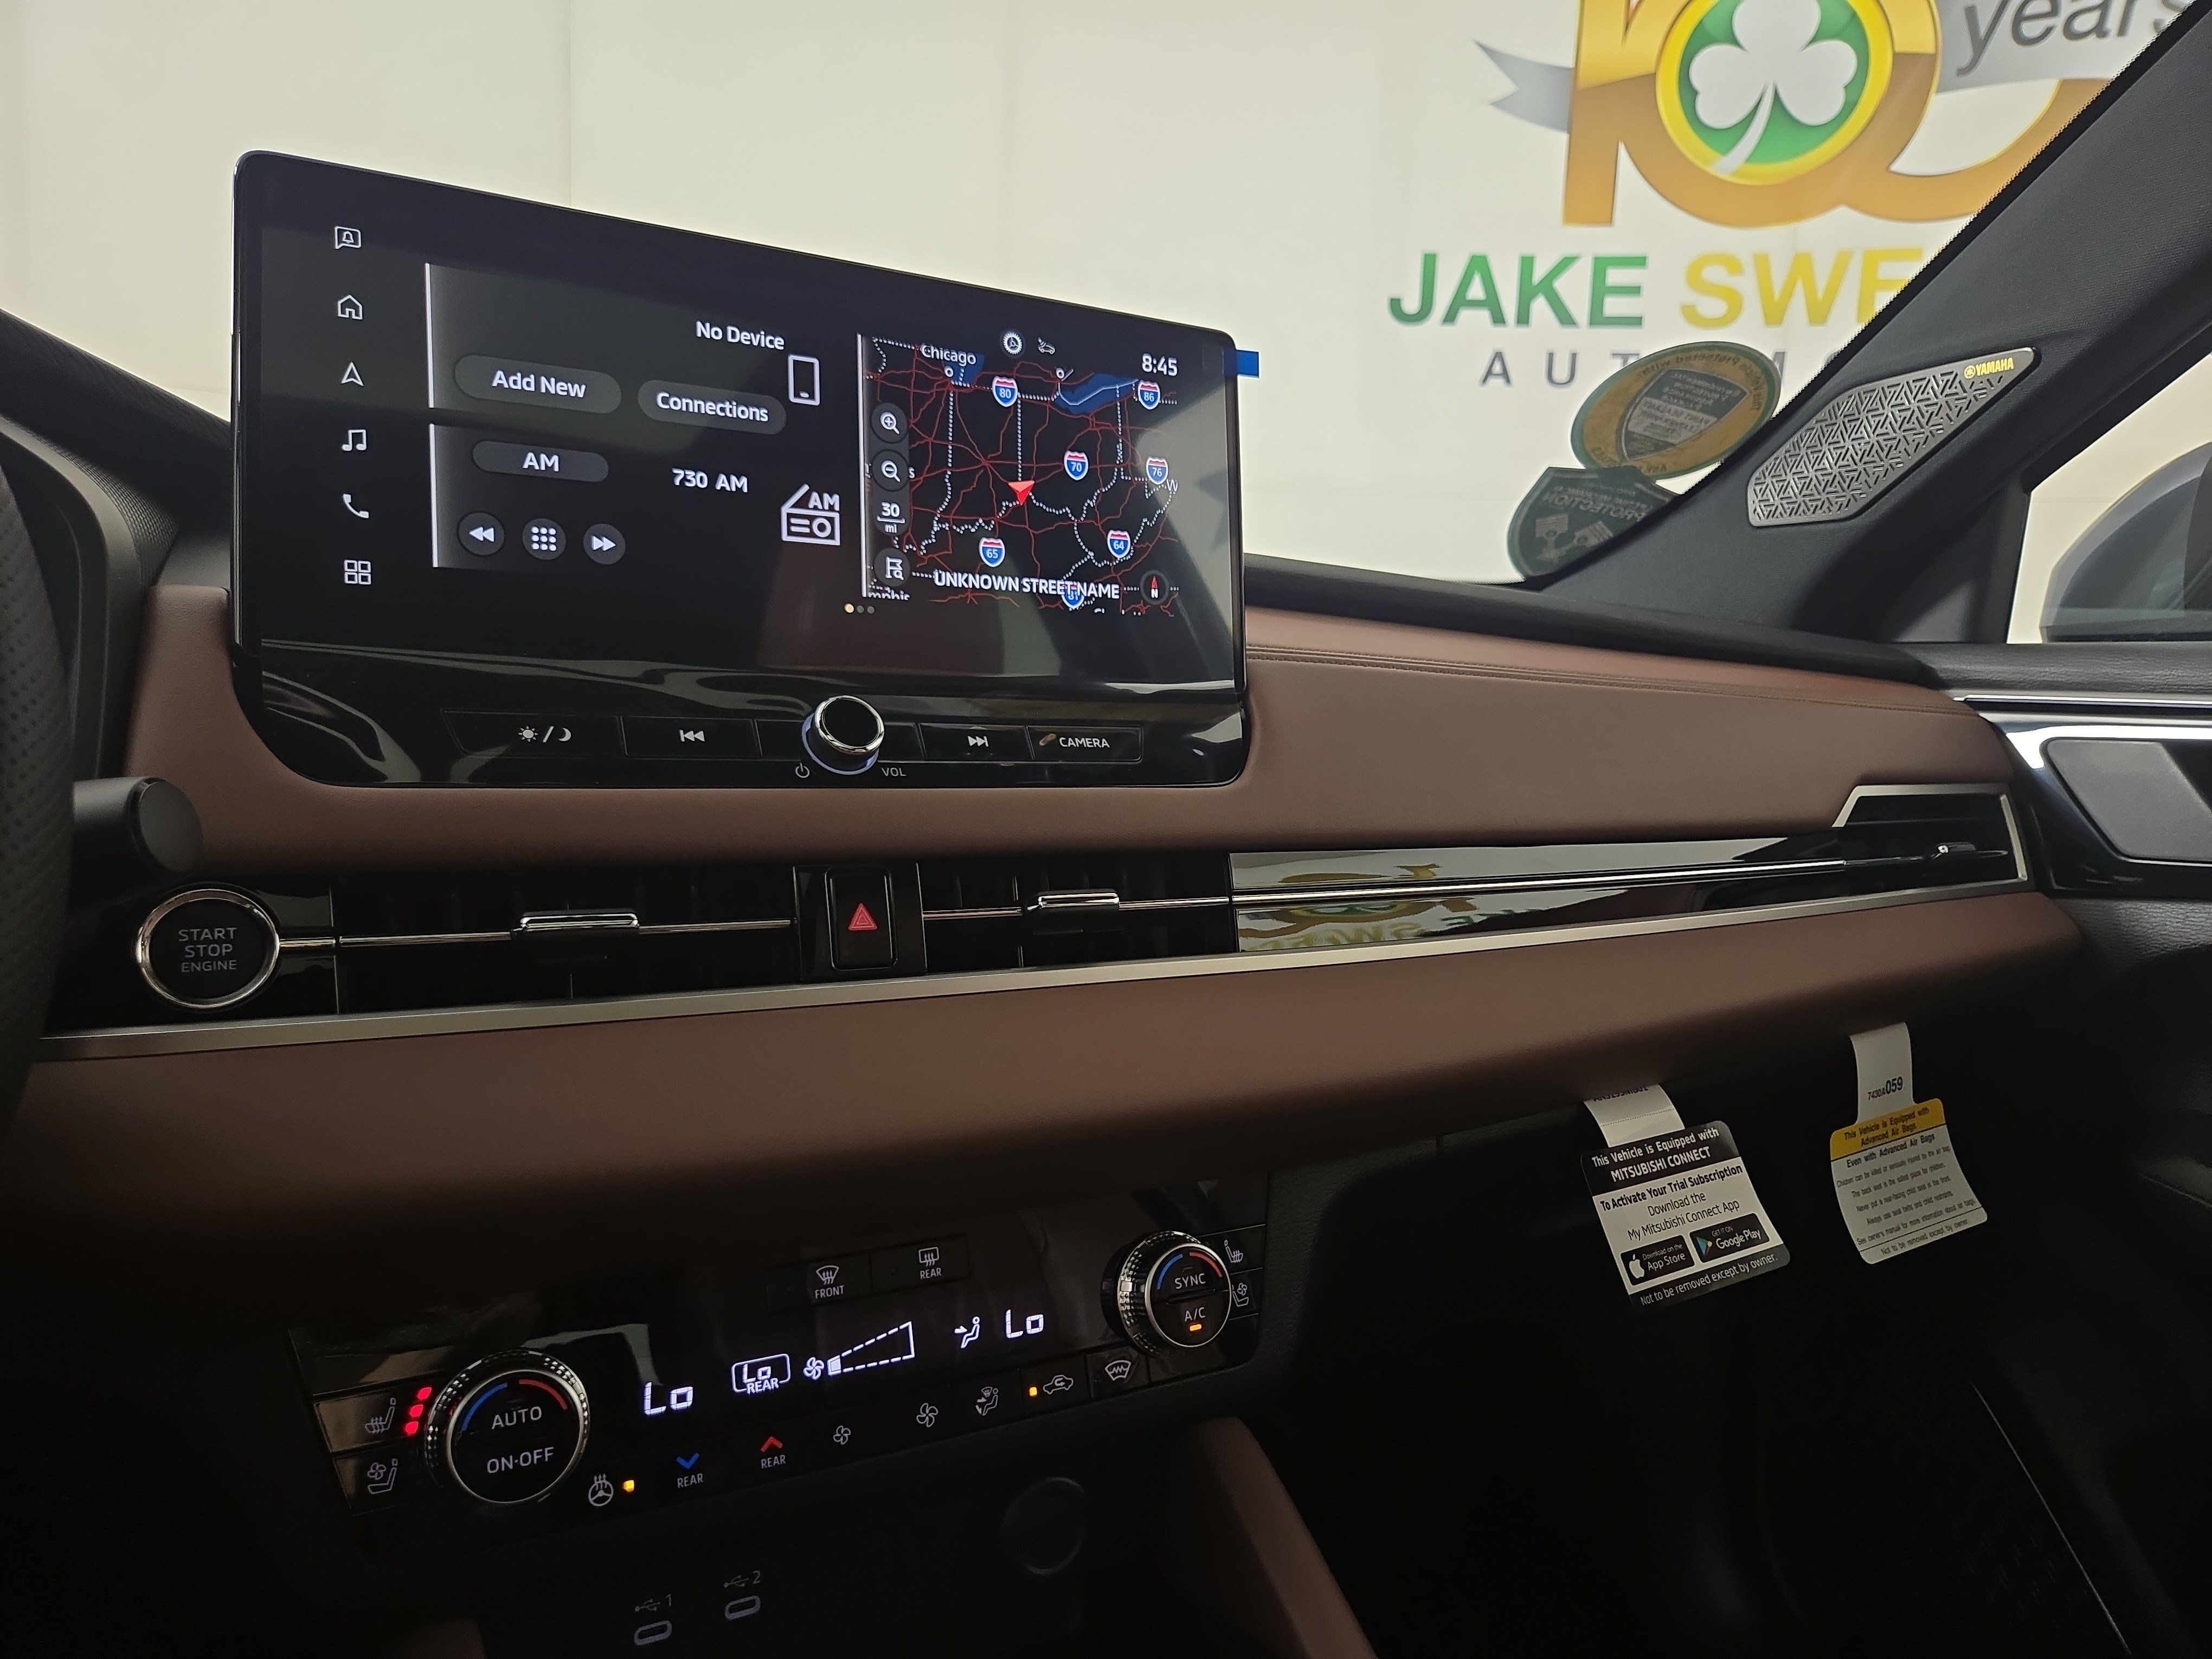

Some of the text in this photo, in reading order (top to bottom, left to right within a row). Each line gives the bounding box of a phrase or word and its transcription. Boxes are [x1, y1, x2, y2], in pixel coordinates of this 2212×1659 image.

[1389, 253, 1648, 328] JAKE
[696, 320, 785, 351] No Device
[921, 343, 977, 367] Chicago
[1142, 353, 1178, 376] 8:45
[1975, 357, 2015, 376] YAMAHA
[491, 369, 587, 399] Add New
[999, 387, 1012, 399] 80
[1143, 391, 1155, 402] 86
[656, 391, 769, 423] Connections
[522, 452, 560, 473] AM
[1070, 461, 1083, 473] 70
[1152, 466, 1163, 478] 76
[672, 468, 749, 493] 730 AM
[808, 492, 840, 511] AM
[881, 501, 900, 517] 30
[885, 523, 897, 533] mi
[986, 547, 999, 560] 65
[1113, 540, 1126, 551] 64
[934, 570, 1120, 600] UNKNOWN STREET NAME
[1150, 588, 1159, 599] N
[1058, 737, 1110, 749] CAMERA
[881, 766, 907, 777] VOL
[178, 927, 238, 942] START
[185, 943, 233, 959] STOP
[181, 959, 238, 974] ENGINE
[1844, 1107, 1930, 1141] This Vehicle is Equipped with
[1861, 1131, 1889, 1147] Advanced
[1902, 1123, 1917, 1133] Bags
[1592, 1127, 1720, 1167] This Vehicle is Equipped with
[1847, 1134, 1935, 1168] Even with Advanced Air Bags
[1610, 1146, 1711, 1182] MITSUBISHI CONNECT
[1600, 1165, 1743, 1211] To Activate Your Trial Subscription
[1647, 1192, 1707, 1217] Download the
[1627, 1199, 1740, 1242] My Mitsubishi Connect App
[1715, 1227, 1762, 1249] Google Play
[1642, 1248, 1667, 1261] Download
[1647, 1252, 1686, 1275] App Store
[919, 1267, 942, 1280] REAR
[1174, 1272, 1206, 1289] SYNC
[1640, 1253, 1778, 1306] Not to be removed except by owner.
[814, 1285, 845, 1299] FRONT
[1184, 1307, 1206, 1322] A/C
[1005, 1309, 1045, 1340] Lo
[742, 1364, 771, 1384] Lo
[746, 1378, 779, 1394] REAR
[644, 1381, 693, 1416] Lo
[491, 1406, 542, 1430] AUTO
[760, 1454, 786, 1469] REAR
[677, 1472, 704, 1489] REAR
[752, 1570, 761, 1585] 2
[665, 1593, 672, 1607] 1
